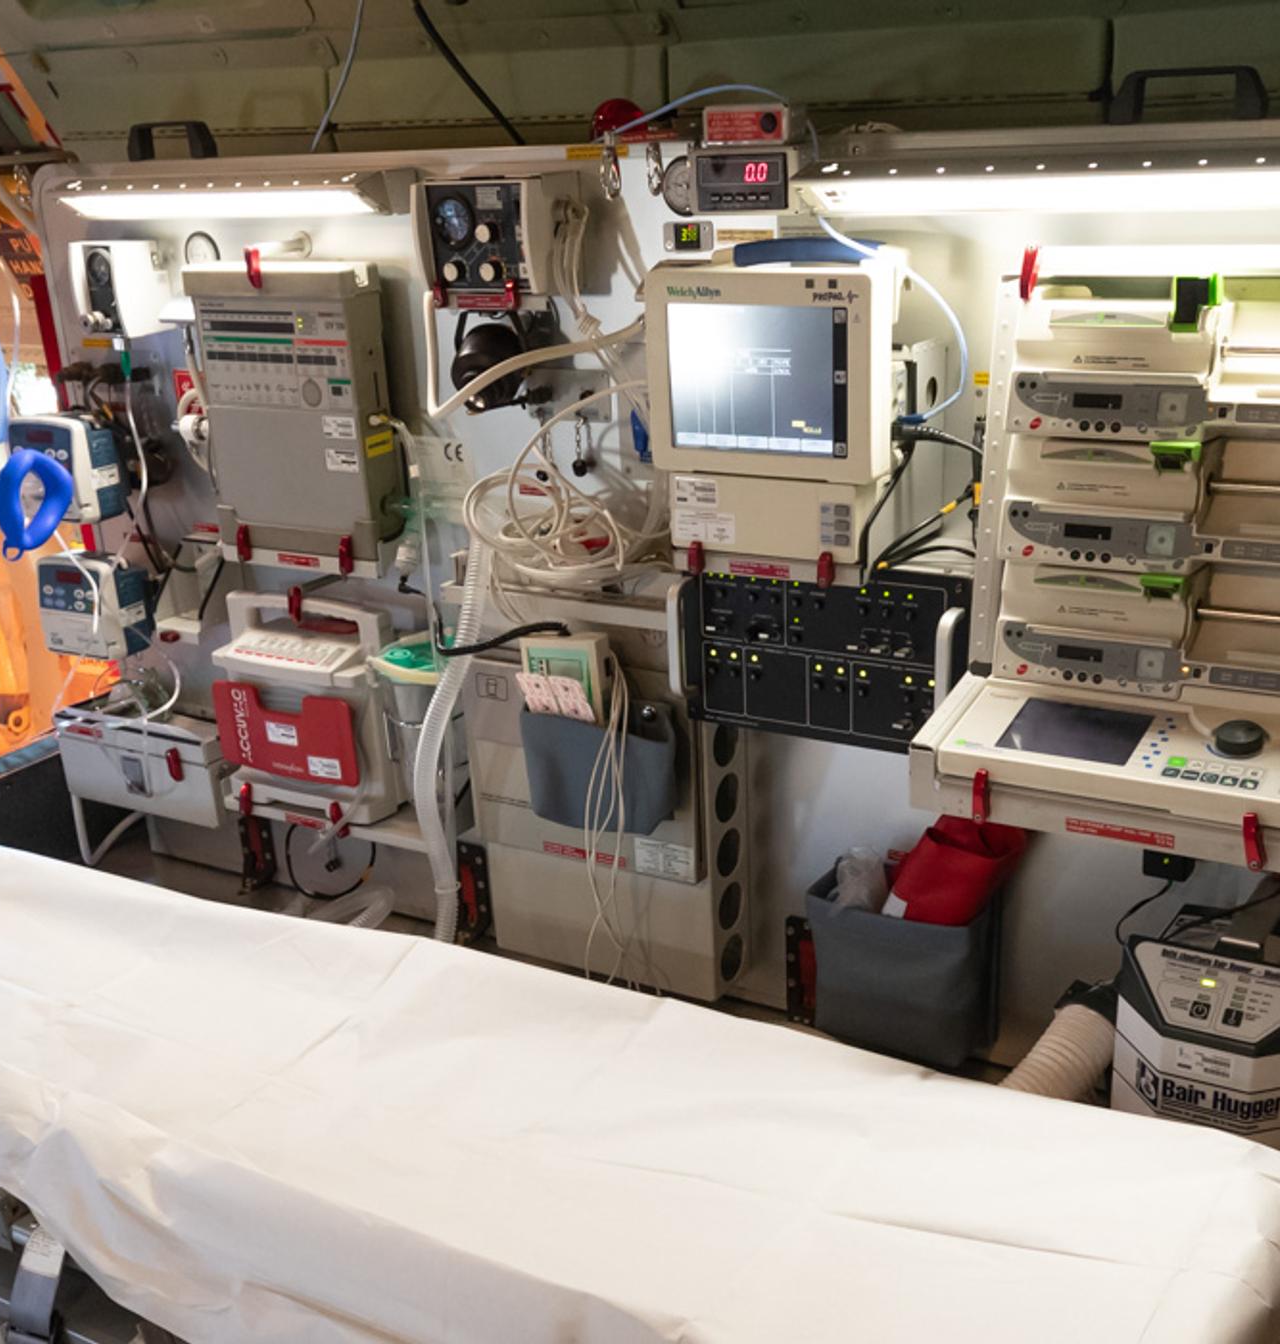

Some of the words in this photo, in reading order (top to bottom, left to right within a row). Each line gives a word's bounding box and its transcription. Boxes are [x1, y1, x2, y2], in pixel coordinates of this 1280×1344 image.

[744, 162, 768, 182] 0.0
[444, 442, 464, 462] CE
[1162, 1077, 1206, 1105] Bair
